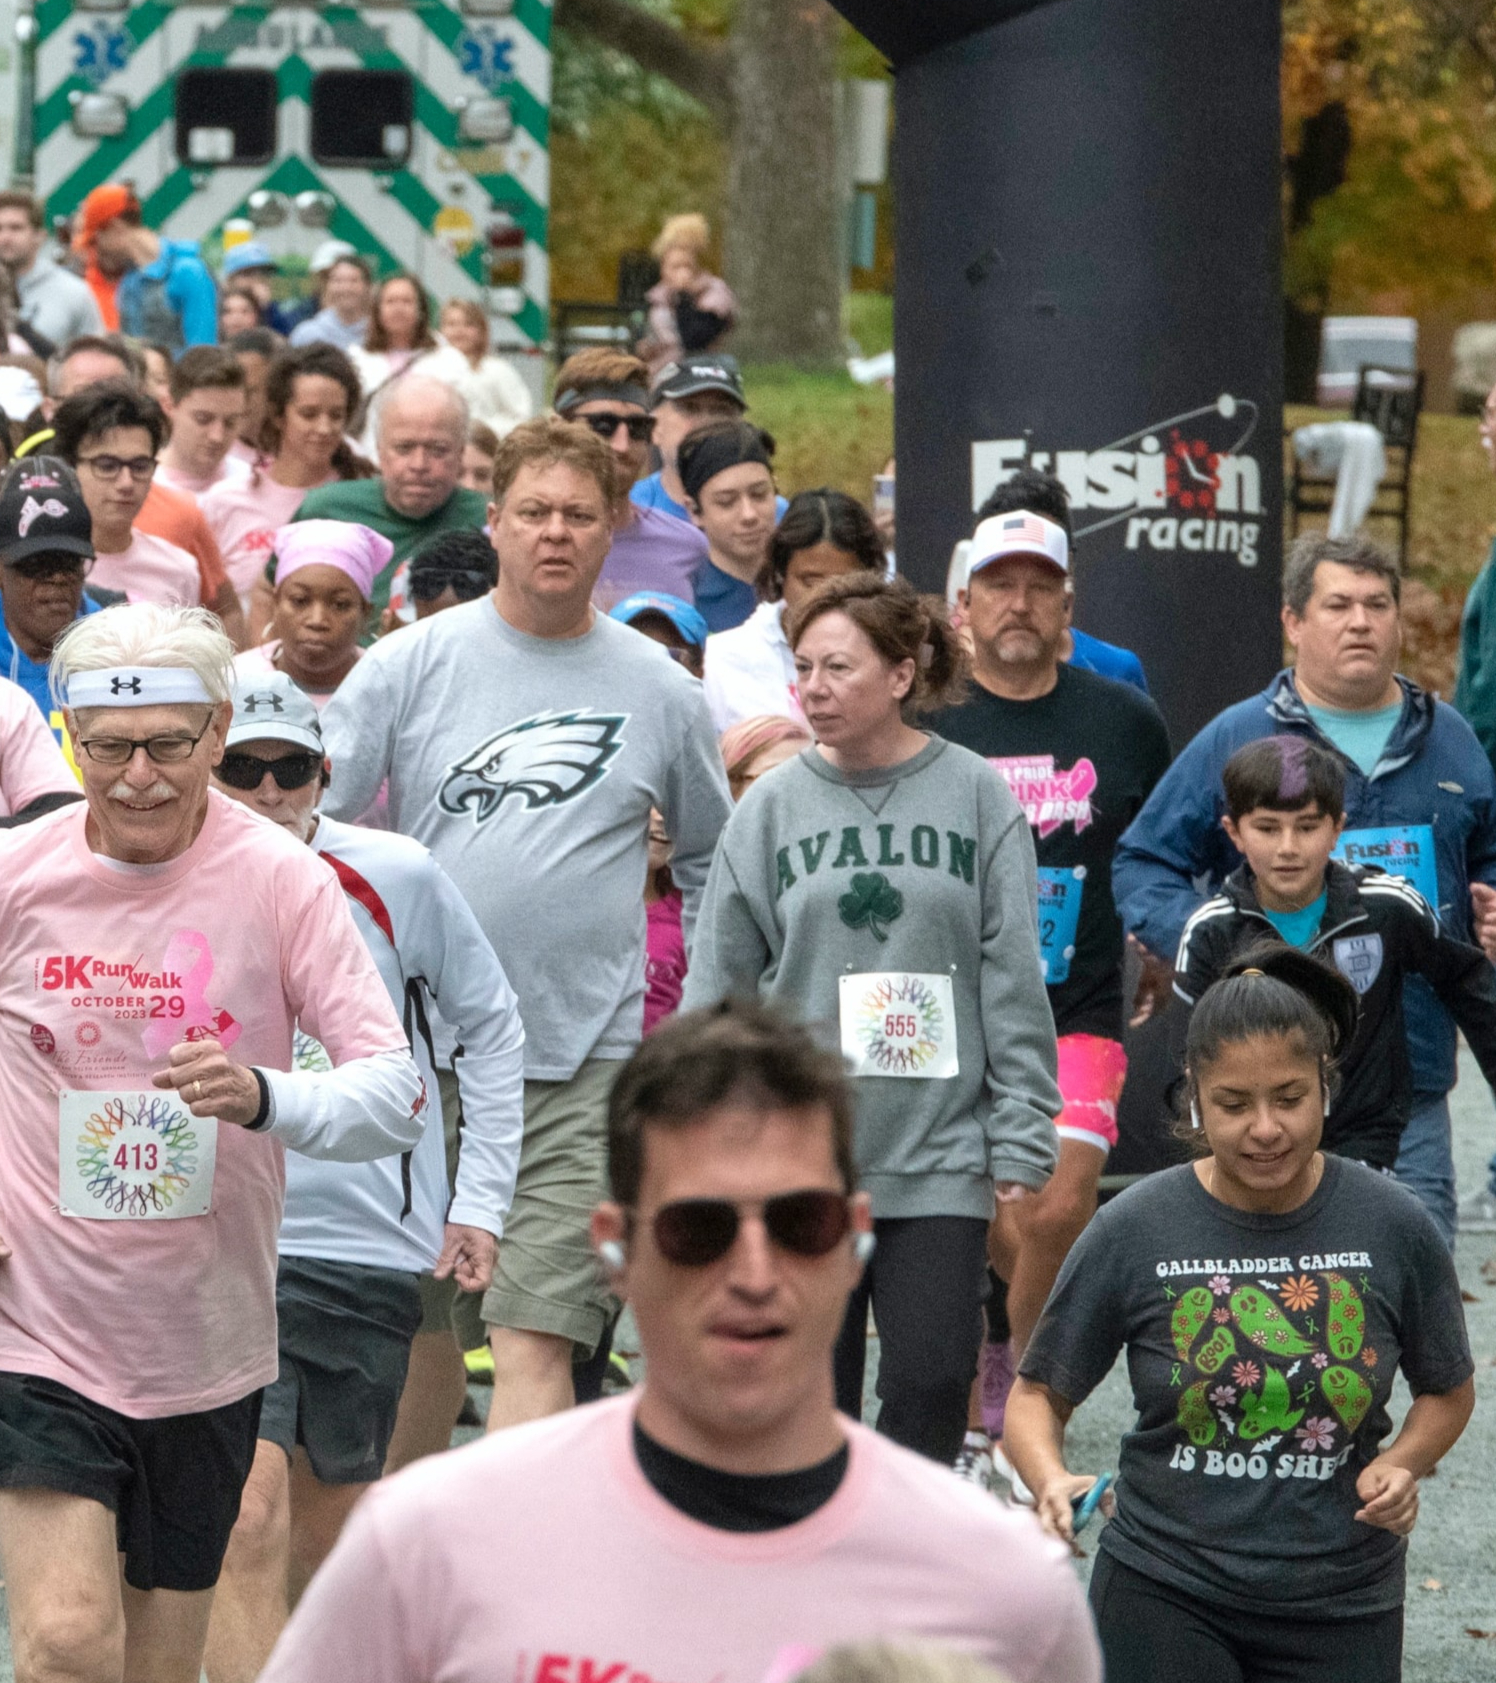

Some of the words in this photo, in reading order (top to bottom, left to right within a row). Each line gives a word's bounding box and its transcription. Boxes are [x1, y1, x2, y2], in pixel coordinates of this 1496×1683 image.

[1124, 516, 1260, 567] racing
[776, 823, 977, 900] AVALON
[42, 955, 93, 990] 5K
[71, 996, 145, 1007] OCTOBER
[149, 995, 185, 1018] 29
[114, 1010, 146, 1019] 2023
[885, 1014, 917, 1038] 555
[113, 1143, 158, 1171] 413
[1156, 1257, 1294, 1278] GALLBLADDER
[1298, 1252, 1373, 1270] CANCER
[1169, 1443, 1196, 1471] IS
[1203, 1450, 1268, 1479] BOO
